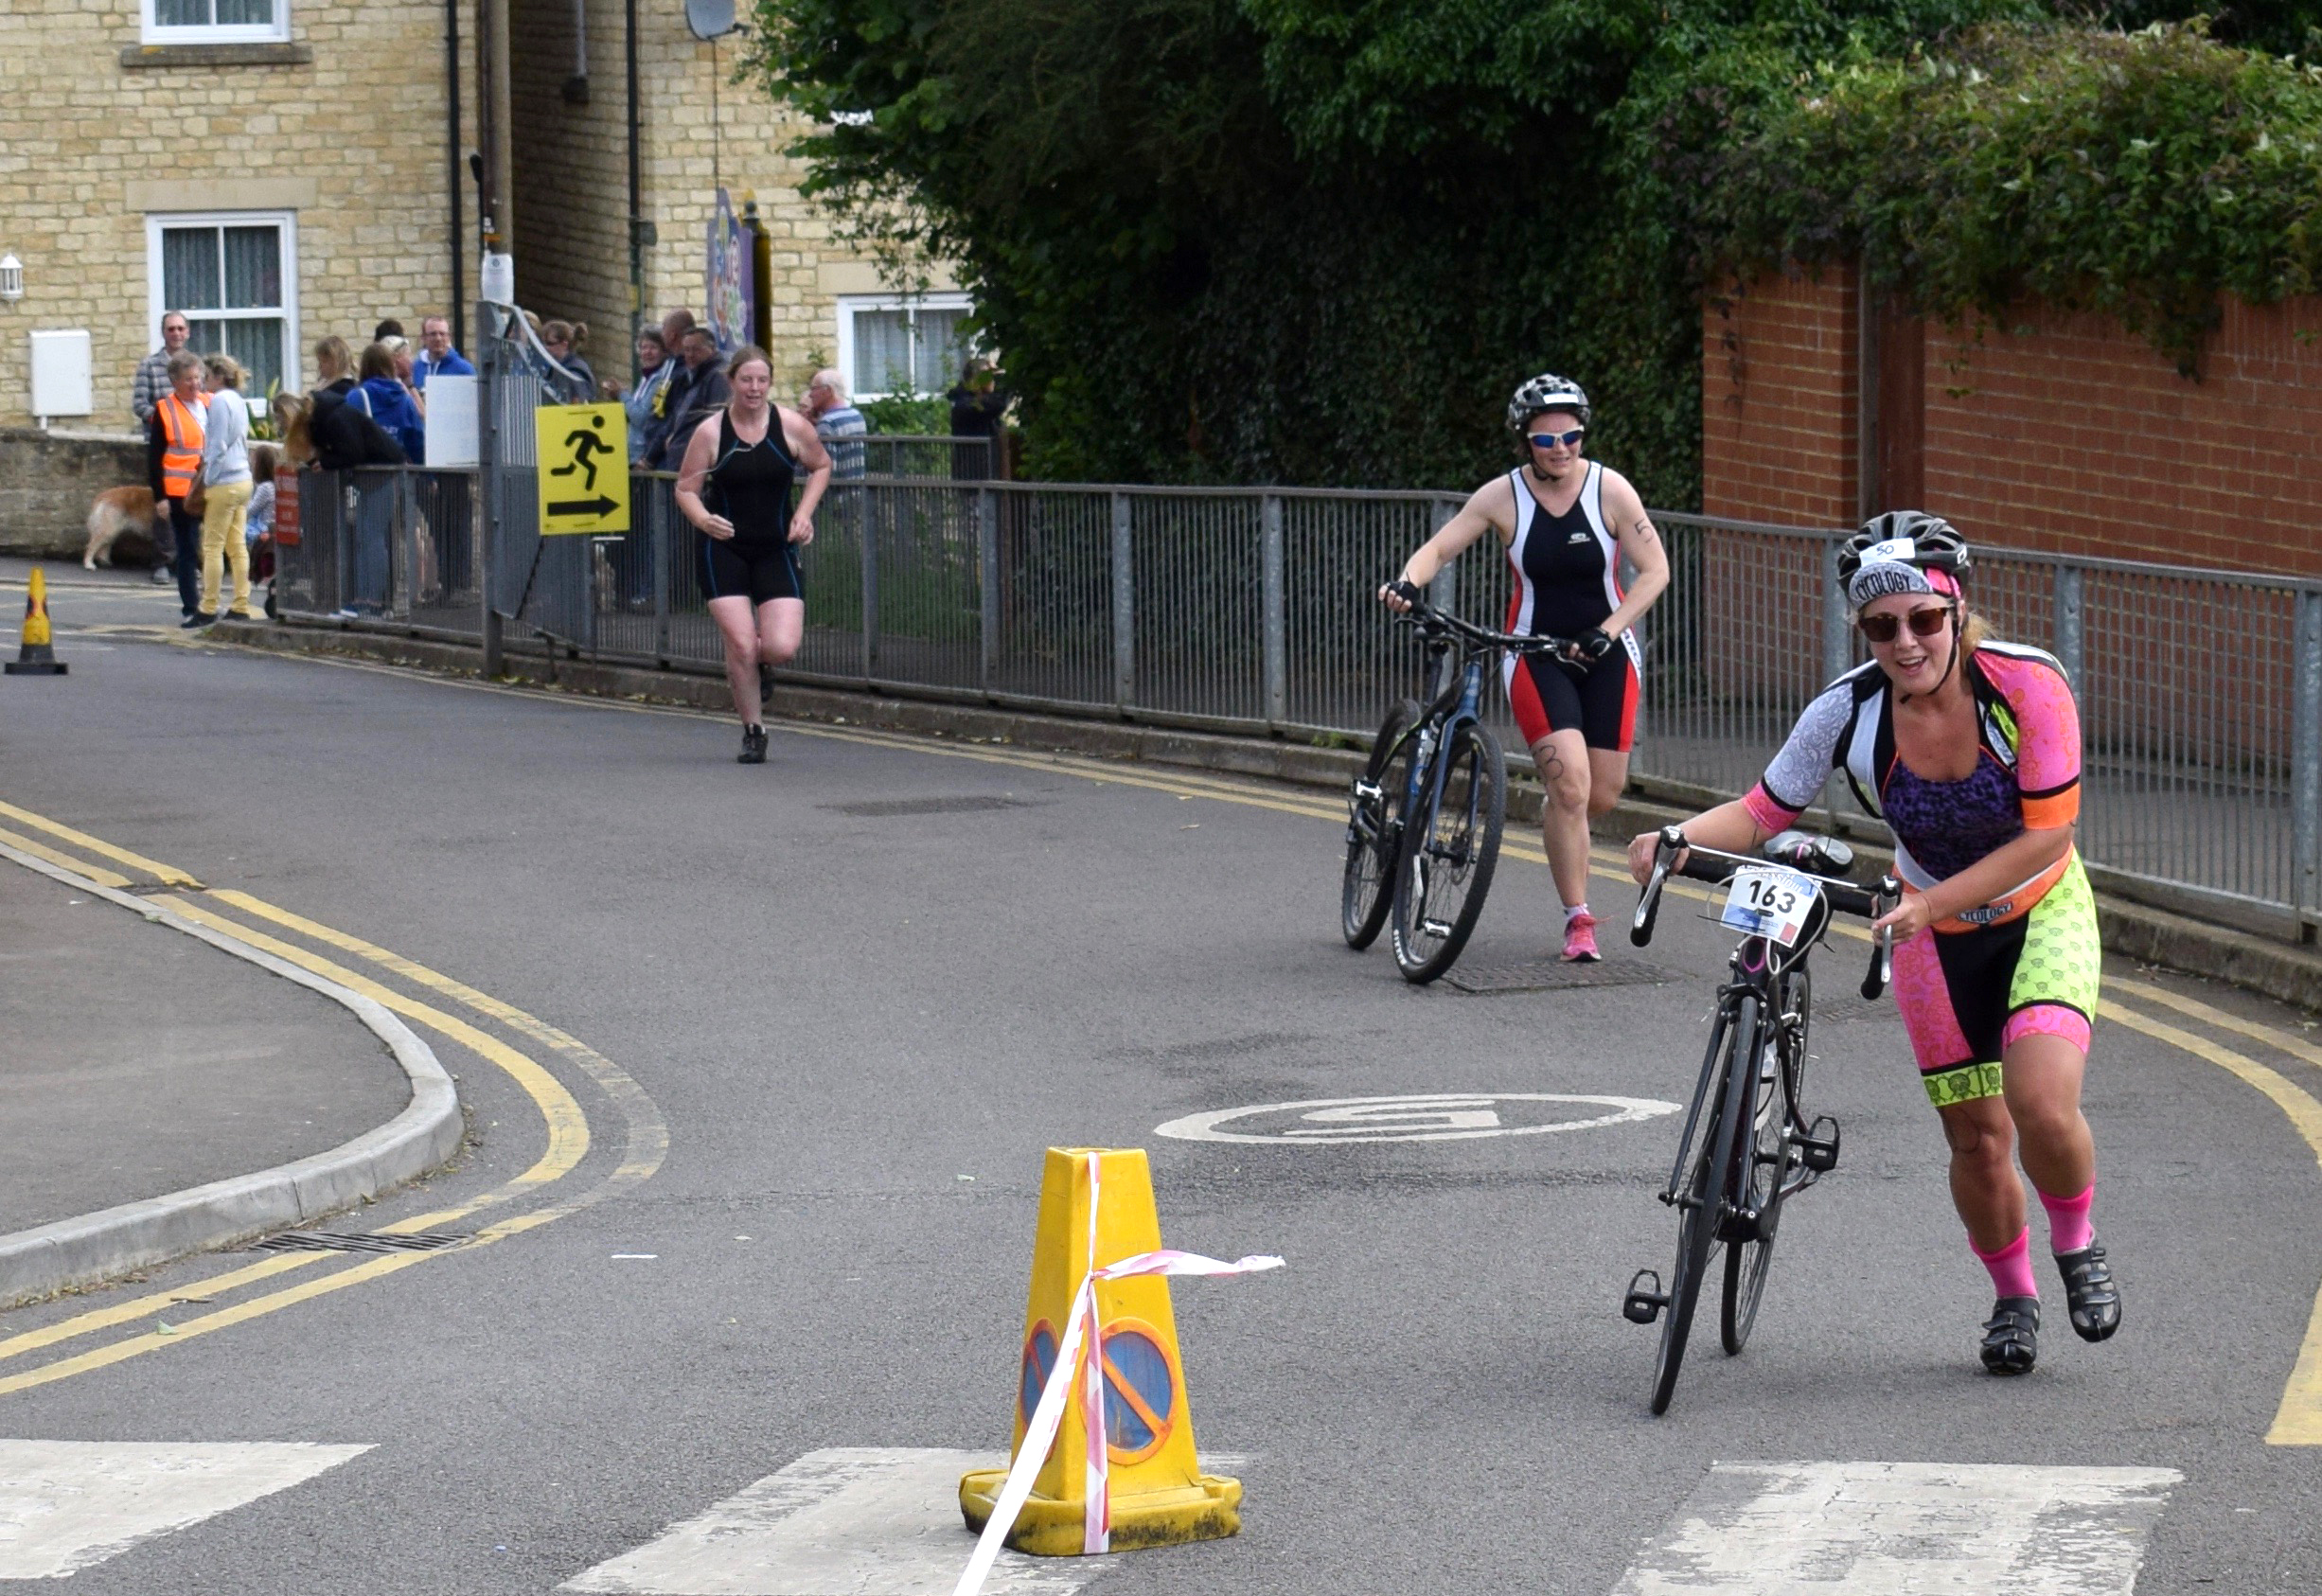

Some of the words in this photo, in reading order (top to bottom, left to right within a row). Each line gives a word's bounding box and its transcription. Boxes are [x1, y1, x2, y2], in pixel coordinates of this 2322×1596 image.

[1635, 518, 1655, 543] 5
[1876, 544, 1895, 557] 50
[1855, 570, 1911, 601] CYCOLOGY
[1748, 879, 1797, 913] 163
